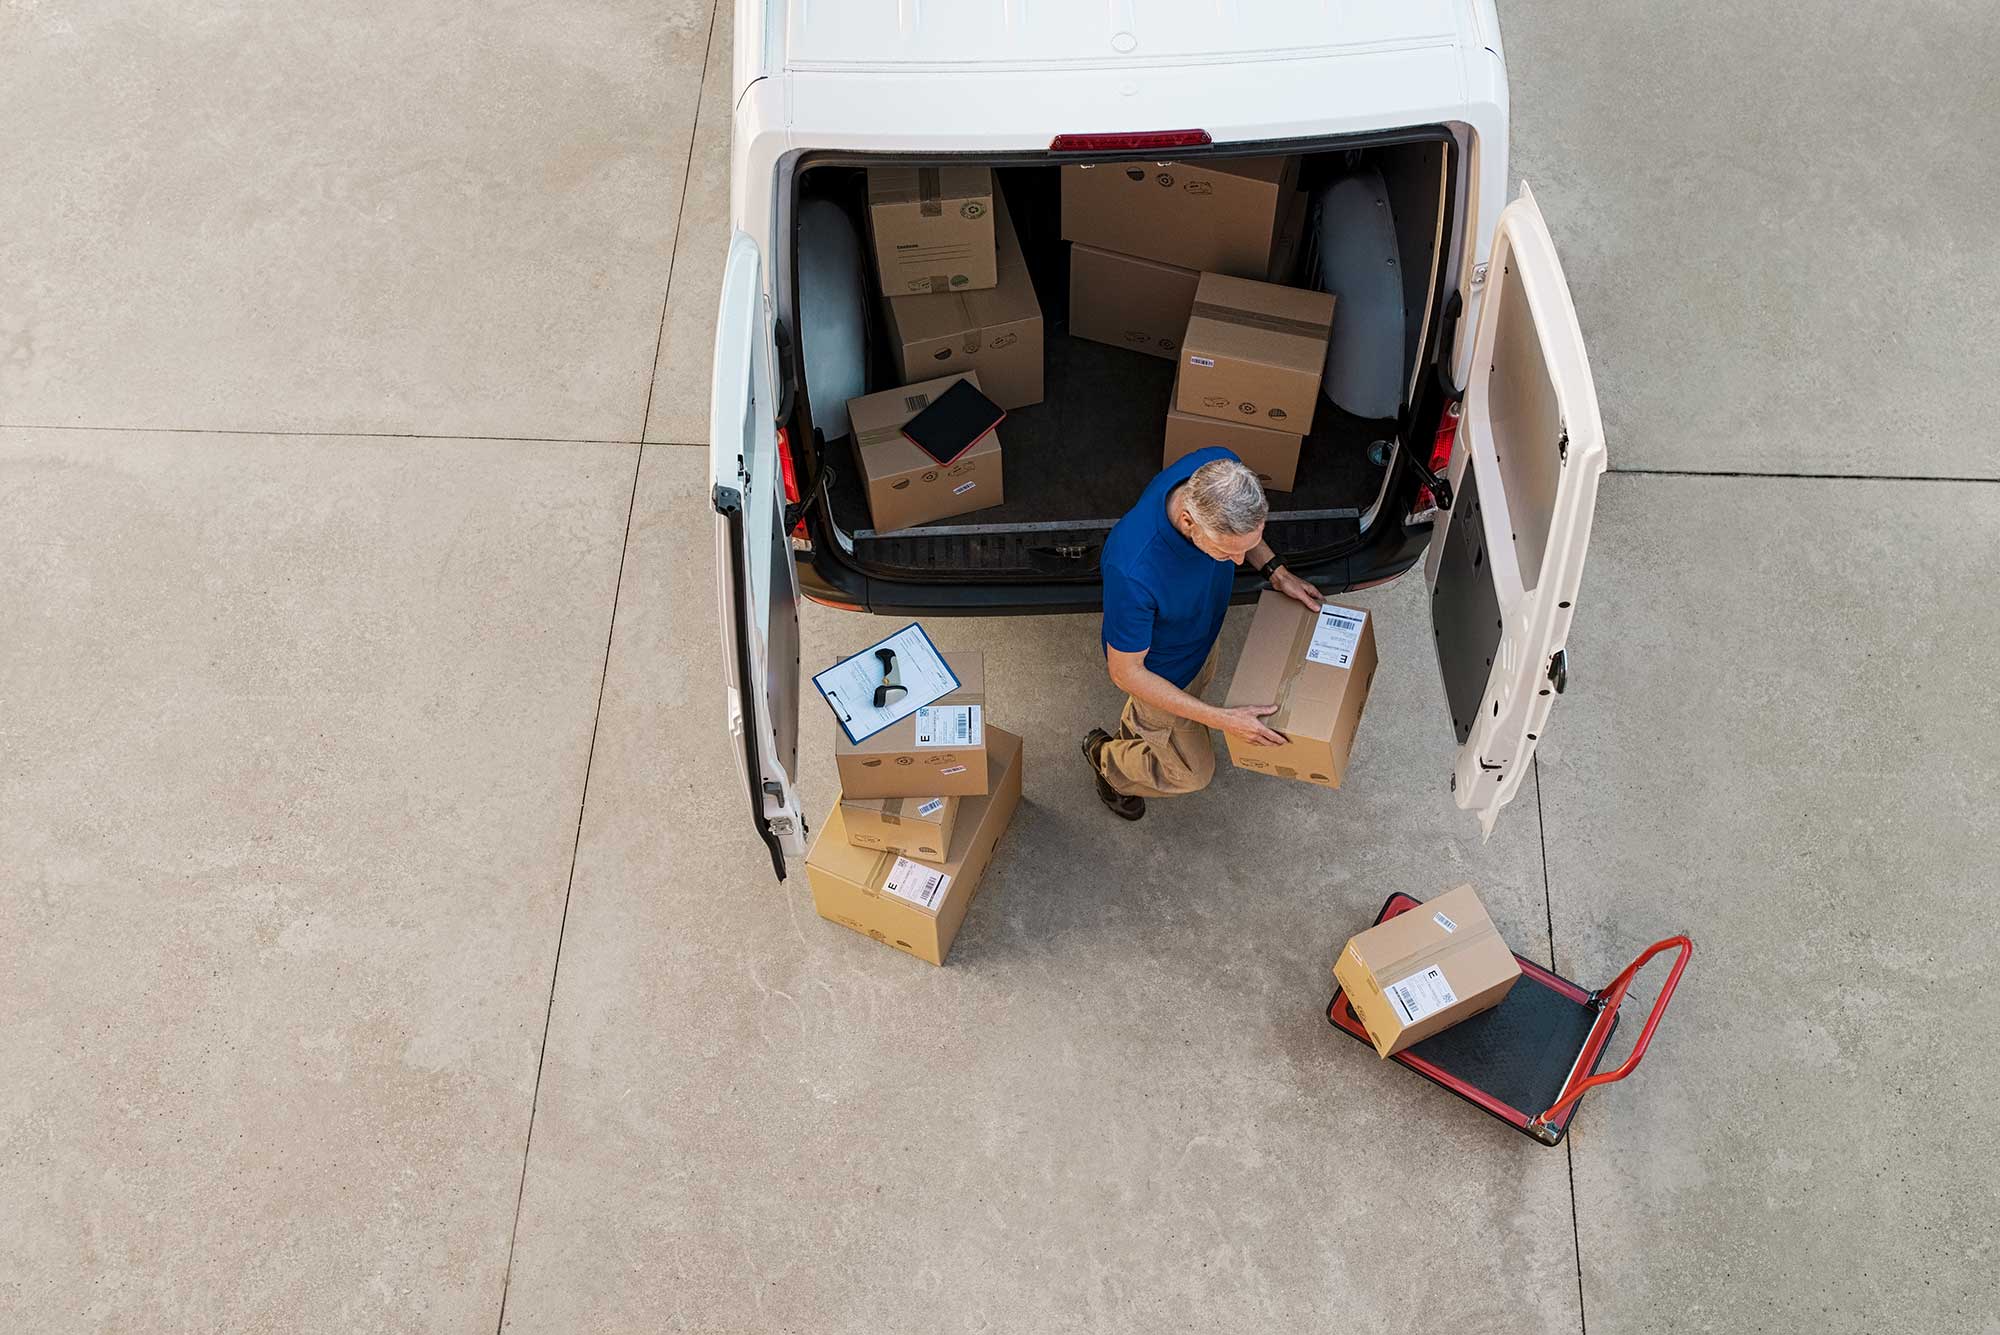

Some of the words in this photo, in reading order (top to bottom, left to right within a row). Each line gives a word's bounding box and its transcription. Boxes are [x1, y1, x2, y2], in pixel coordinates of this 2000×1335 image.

[1339, 655, 1348, 664] E
[888, 883, 898, 891] E
[1428, 970, 1438, 979] E
